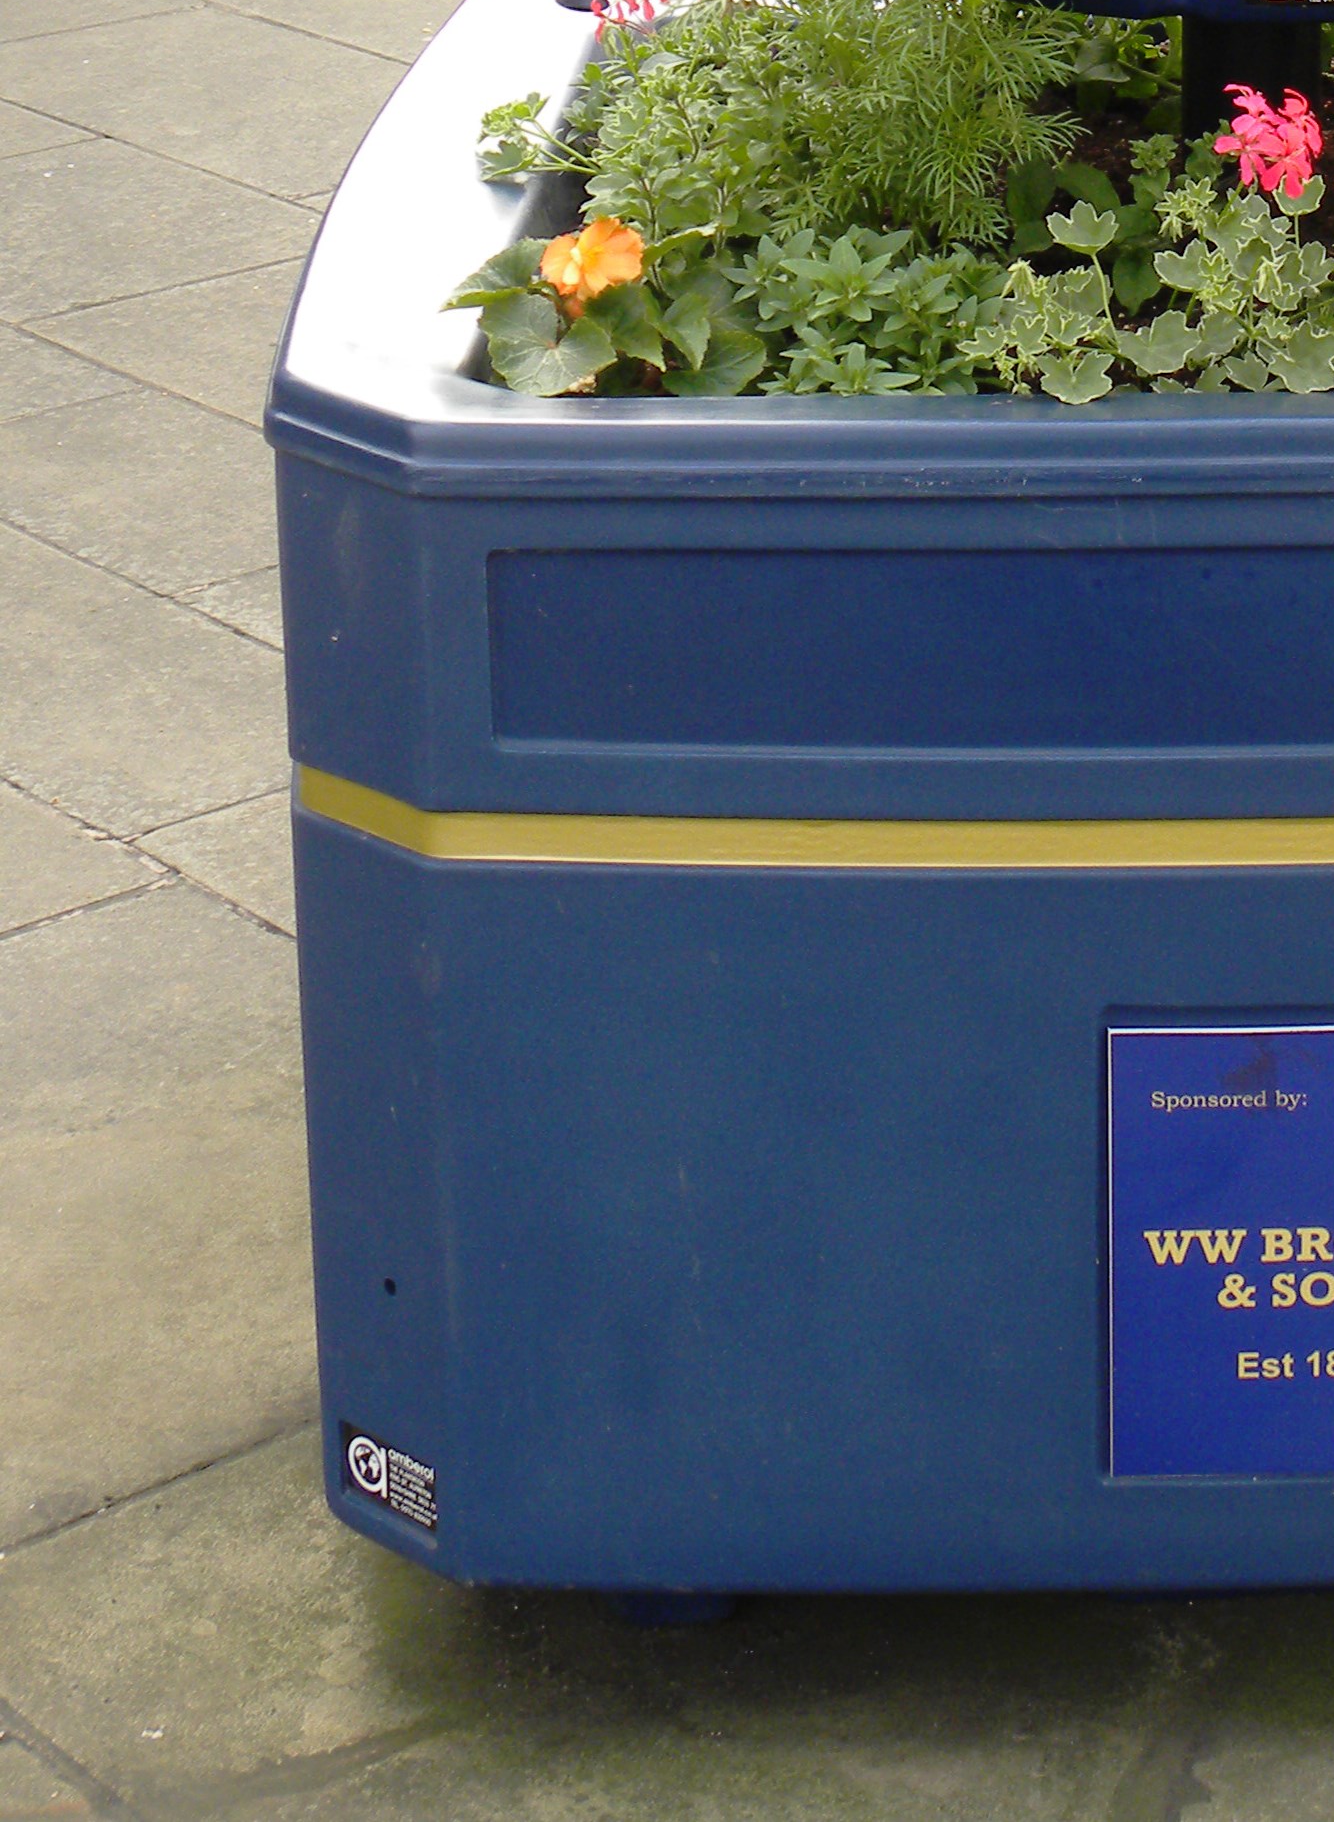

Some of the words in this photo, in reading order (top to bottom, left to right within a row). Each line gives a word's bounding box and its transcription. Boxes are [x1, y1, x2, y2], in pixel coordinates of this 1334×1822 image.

[1151, 1090, 1267, 1113] Sponsored
[1275, 1089, 1307, 1111] by:
[1144, 1229, 1247, 1265] WW
[1217, 1274, 1256, 1308] &
[1237, 1352, 1294, 1378] Est
[388, 1449, 434, 1481] amberol
